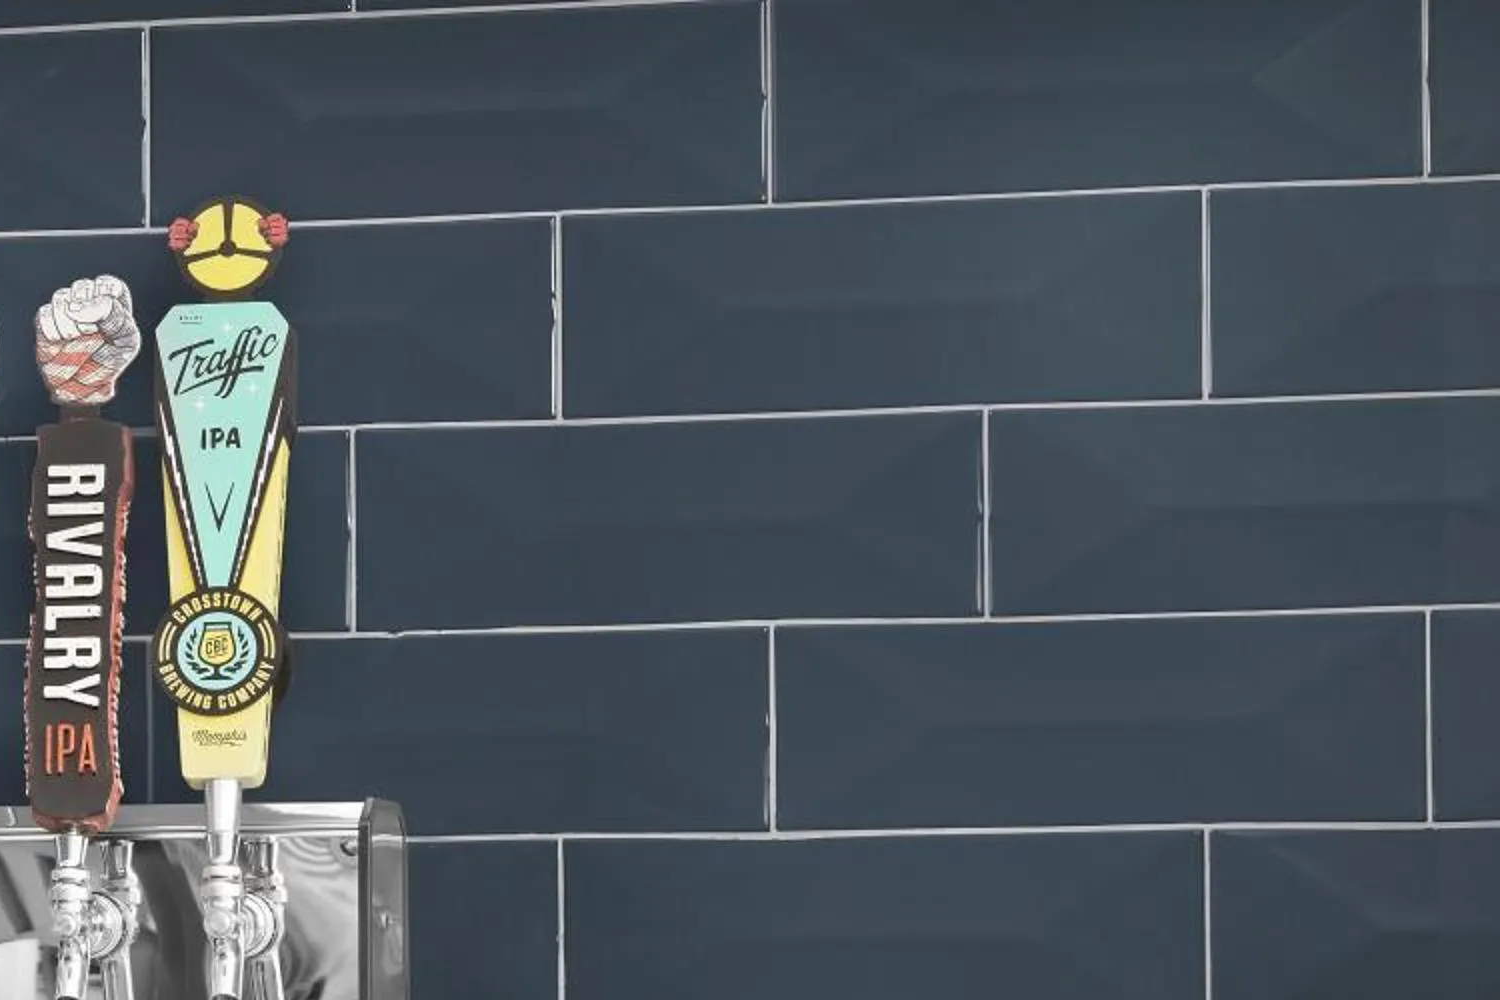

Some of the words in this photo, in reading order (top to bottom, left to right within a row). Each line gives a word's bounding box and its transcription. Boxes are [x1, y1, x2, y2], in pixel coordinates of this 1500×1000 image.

[168, 325, 278, 399] Traffic
[200, 427, 241, 450] IPA
[43, 463, 105, 707] RIVALRY
[172, 592, 263, 624] CROSSTOWN
[159, 663, 213, 709] BREWING
[217, 661, 275, 709] COMPANY
[44, 723, 98, 776] IPA
